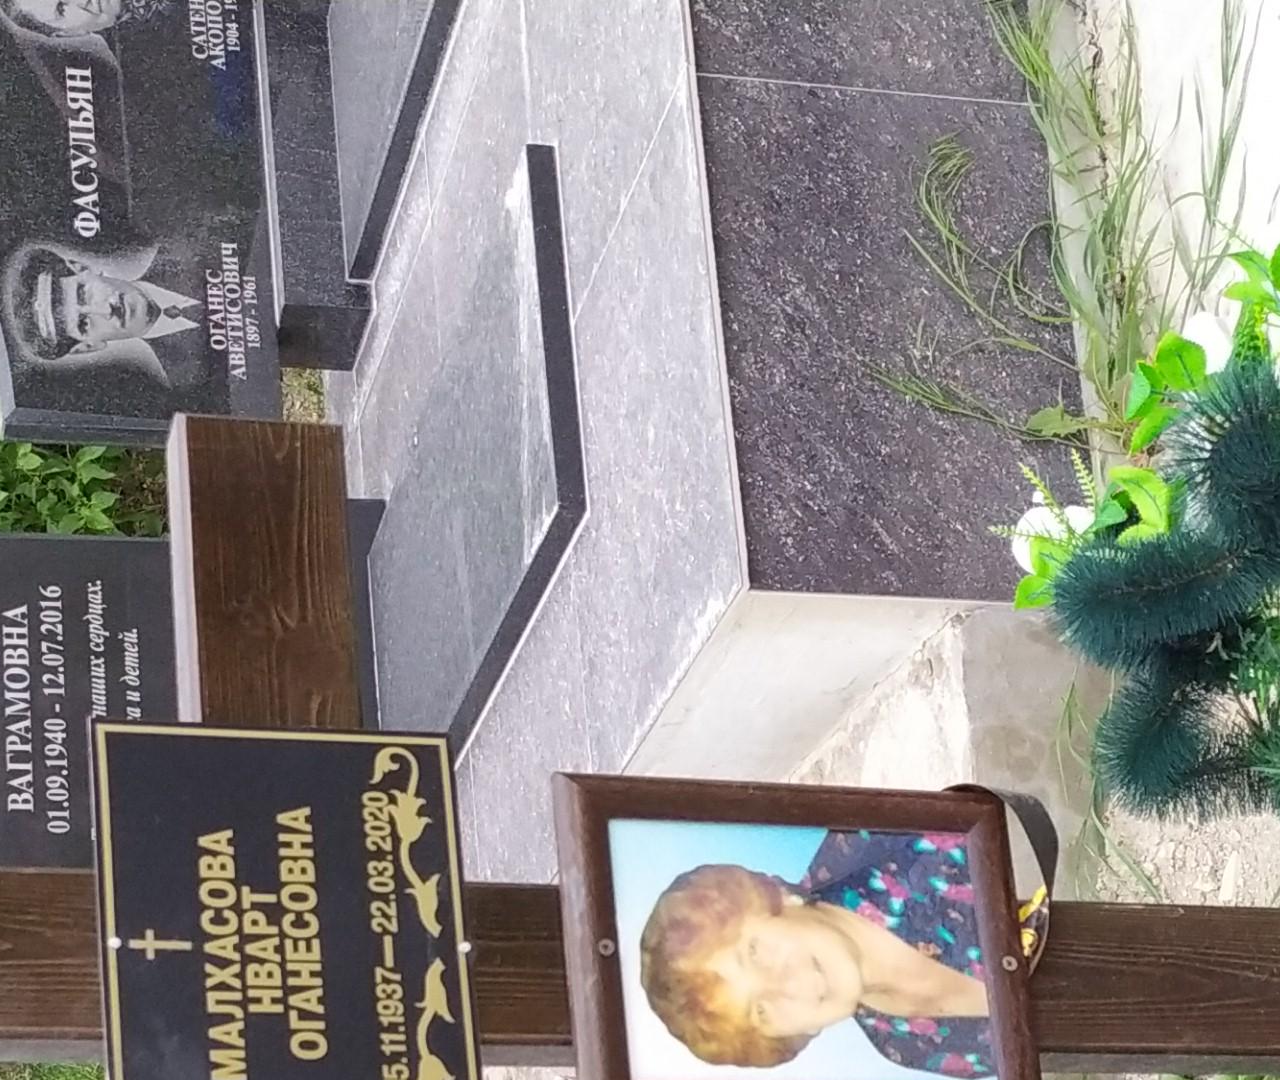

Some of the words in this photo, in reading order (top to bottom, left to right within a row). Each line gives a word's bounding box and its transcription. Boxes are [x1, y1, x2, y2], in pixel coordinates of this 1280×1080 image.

[225, 23, 240, 51] 1904
[66, 66, 102, 237] ФАСУЛЬЯН
[206, 269, 227, 350] ОГАНЕС
[222, 242, 247, 380] АВЕТИСОВИЧ
[243, 276, 257, 304] 1961
[246, 318, 262, 348] 1897
[39, 585, 66, 696] 12.07.2016
[83, 580, 109, 651] сердцах.
[90, 656, 107, 717] наших
[118, 628, 140, 686] детей.
[126, 691, 141, 701] и
[2, 604, 34, 812] ВАГРАМОВНА
[44, 718, 70, 834] 01.09.1940
[241, 886, 284, 1013] НВАРТ
[276, 807, 328, 1061] ОГАНЕСОВНА
